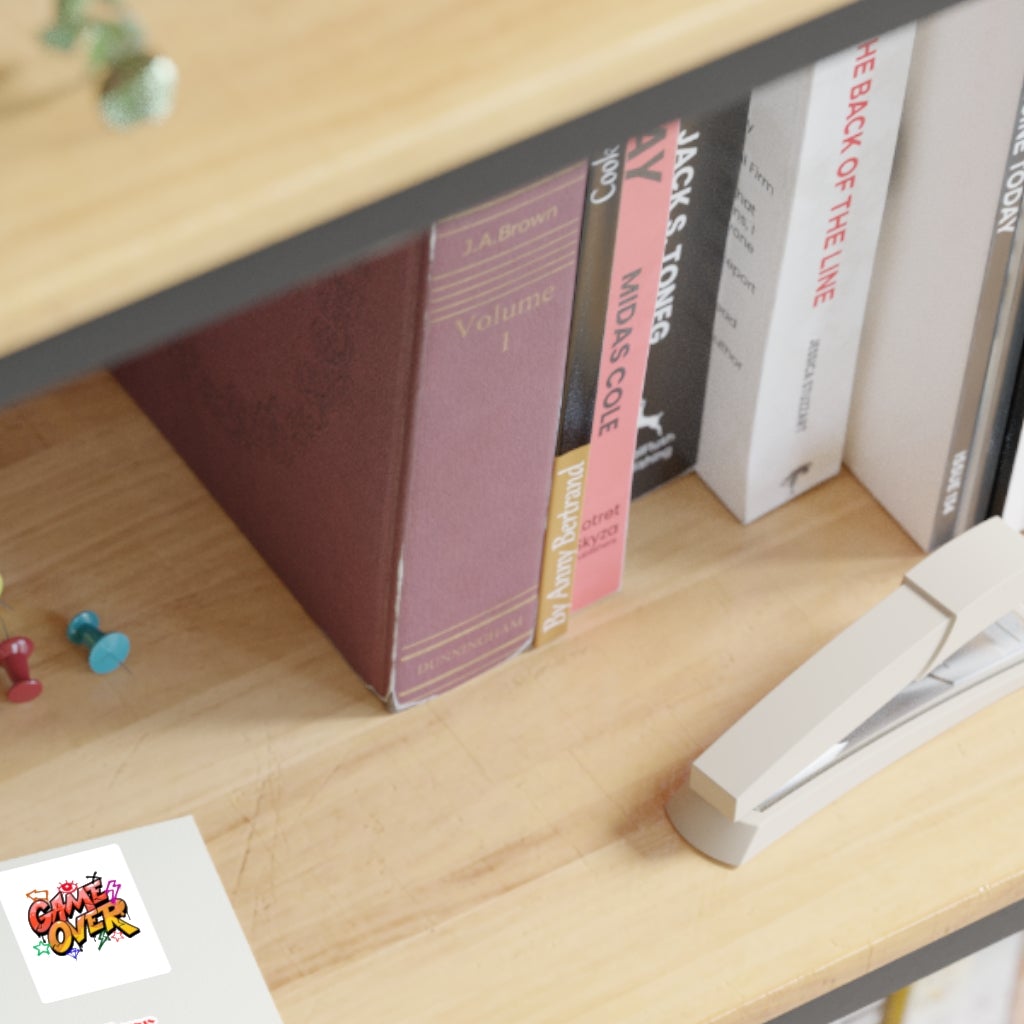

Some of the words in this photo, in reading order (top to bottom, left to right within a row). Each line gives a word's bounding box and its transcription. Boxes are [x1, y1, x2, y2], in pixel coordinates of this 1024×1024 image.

[840, 78, 872, 154] BACK
[668, 128, 701, 213] JACK
[748, 161, 775, 196] Firm
[834, 156, 859, 192] OF
[823, 195, 854, 251] THE
[813, 249, 843, 308] LINE
[455, 284, 556, 338] Volume
[609, 267, 643, 364] MIDAS
[598, 366, 627, 438] COLE
[551, 459, 586, 551] Bertrand
[542, 600, 572, 633] By
[28, 876, 110, 938] GAME
[47, 897, 141, 957] OVER
